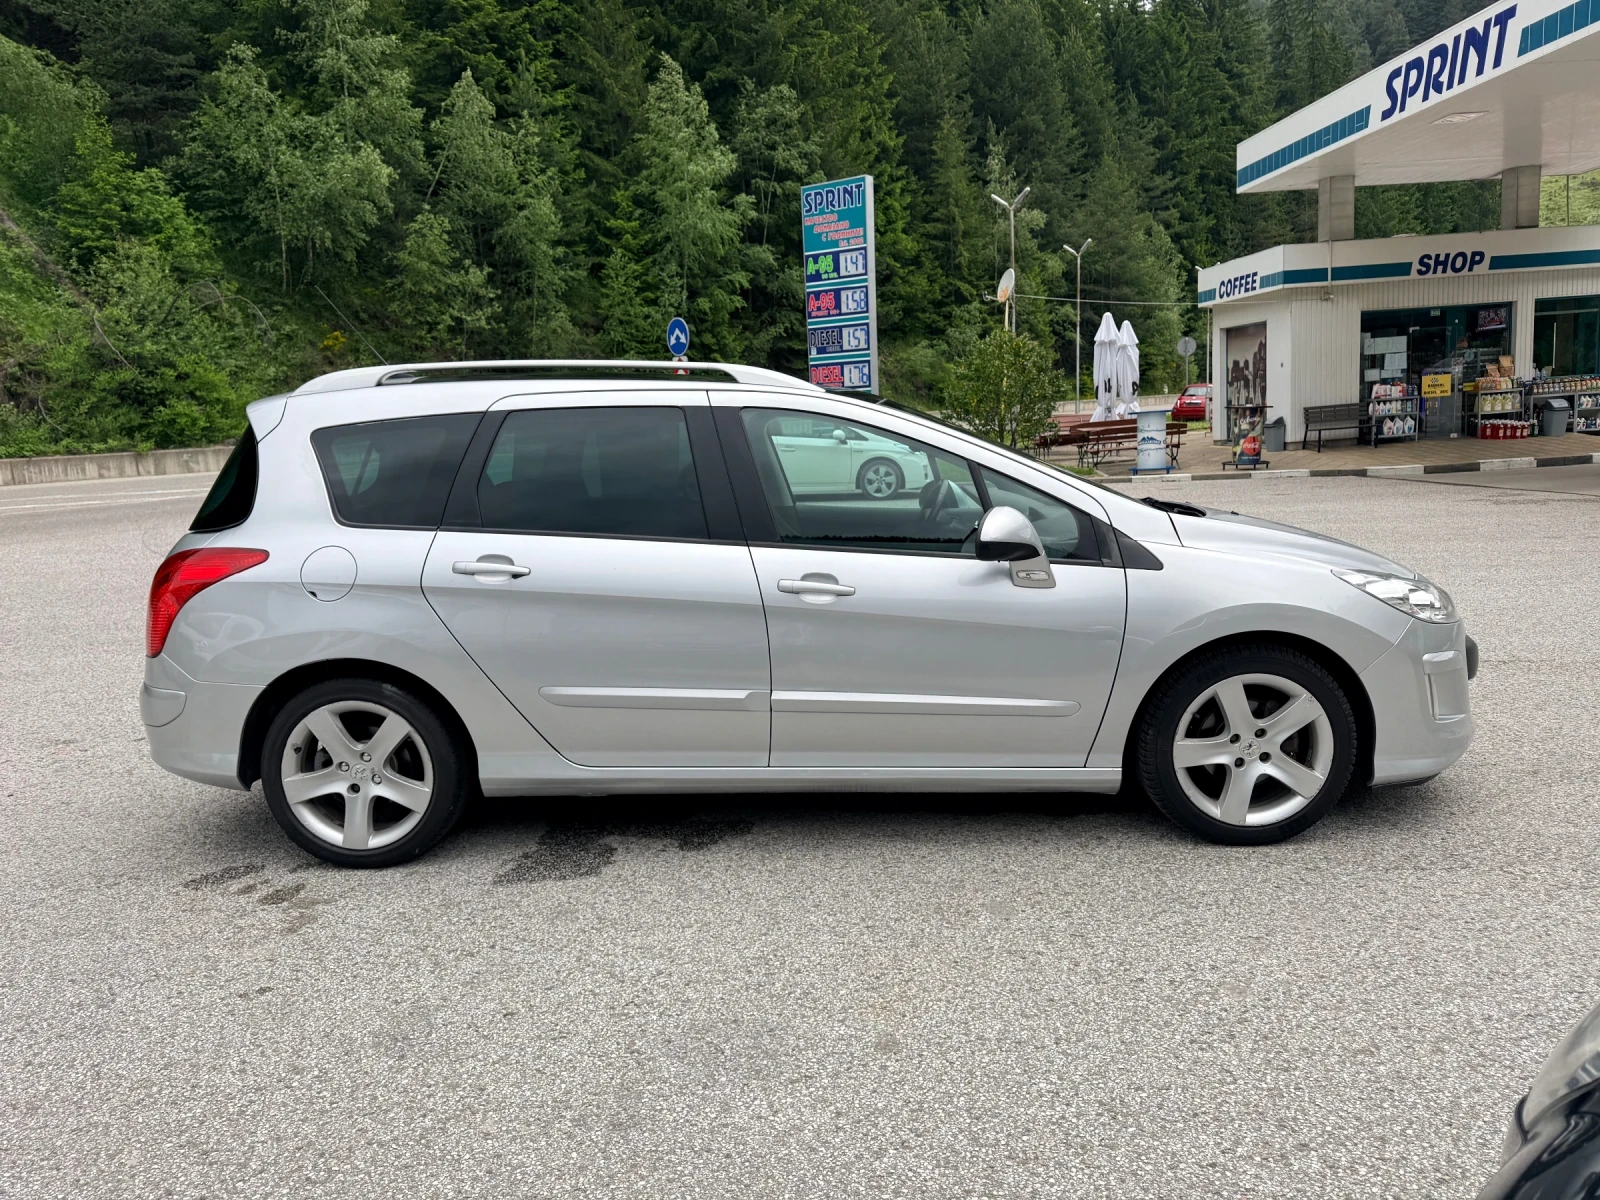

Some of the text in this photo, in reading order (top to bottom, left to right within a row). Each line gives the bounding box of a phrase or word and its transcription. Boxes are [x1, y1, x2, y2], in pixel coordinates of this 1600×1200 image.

[1381, 3, 1518, 122] SPRINT
[804, 183, 863, 214] SPRINT
[807, 252, 866, 275] A-95 1.47
[1417, 250, 1486, 276] SHOP
[1218, 271, 1258, 299] COFFEE
[809, 290, 867, 311] A-95 1.58
[810, 327, 867, 348] DIESEL 1.57
[811, 364, 869, 385] DIESEL 1.76
